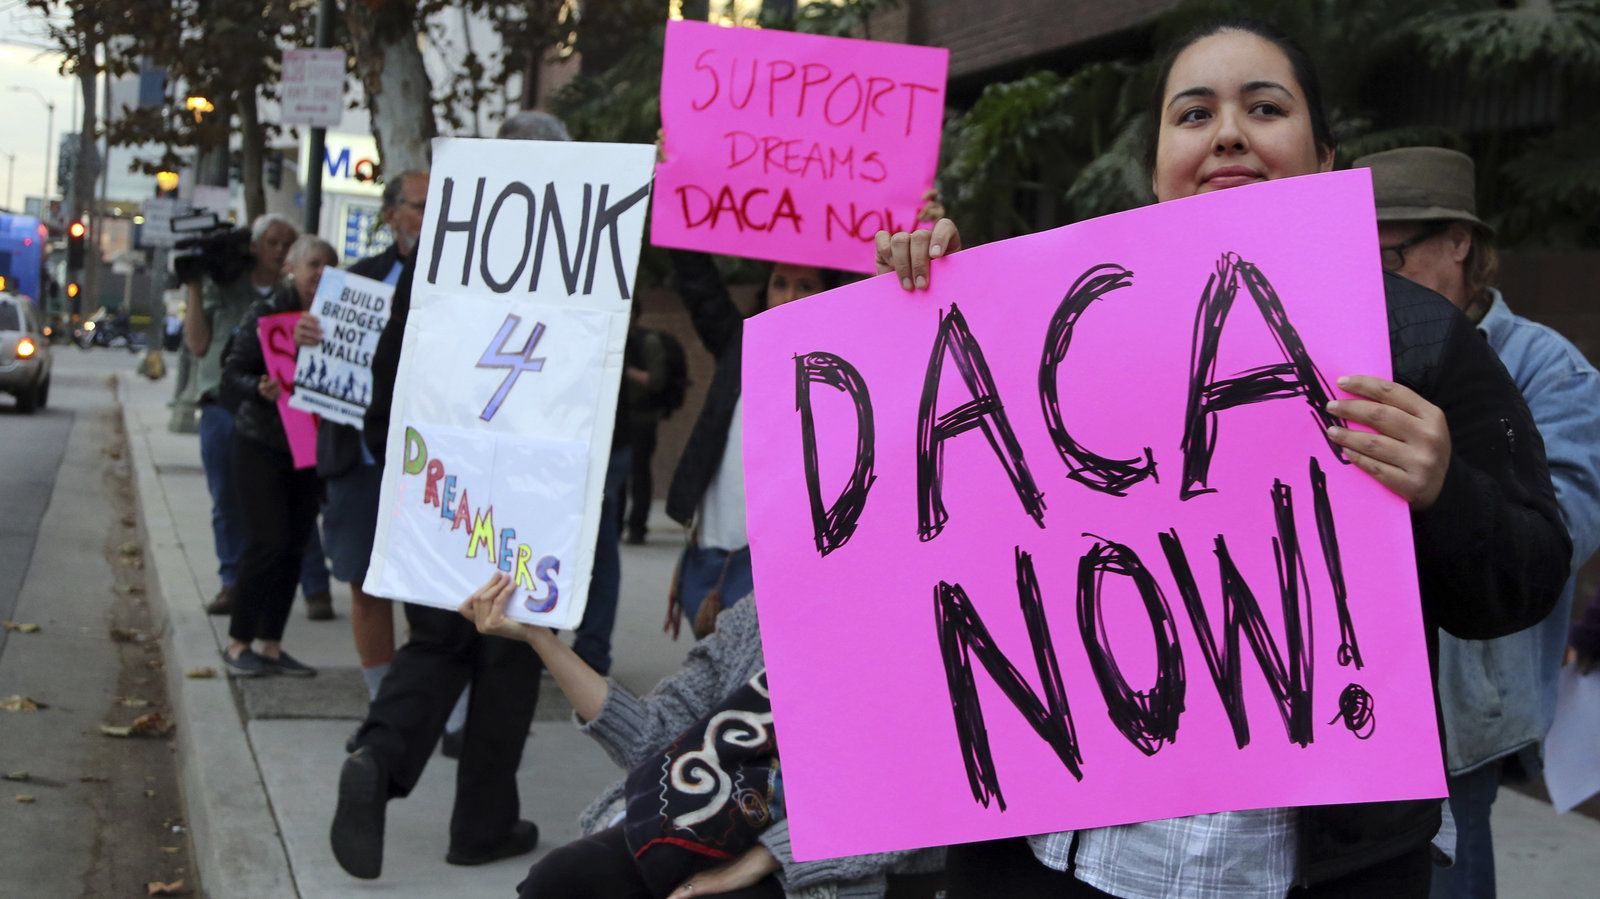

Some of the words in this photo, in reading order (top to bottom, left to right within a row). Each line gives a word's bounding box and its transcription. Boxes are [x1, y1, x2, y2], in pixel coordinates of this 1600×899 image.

[691, 48, 939, 137] SUPPORT
[723, 130, 888, 183] DREAMS
[427, 176, 654, 300] HONK
[675, 184, 802, 234] DACA
[322, 302, 384, 331] BRIDGES
[341, 287, 384, 312] BUILD
[321, 341, 370, 367] WALLS
[334, 325, 367, 346] NOT
[476, 313, 546, 422] 4
[793, 251, 1354, 557] DACA
[403, 425, 561, 614] DREAMERS
[934, 456, 1375, 812] NOW!
